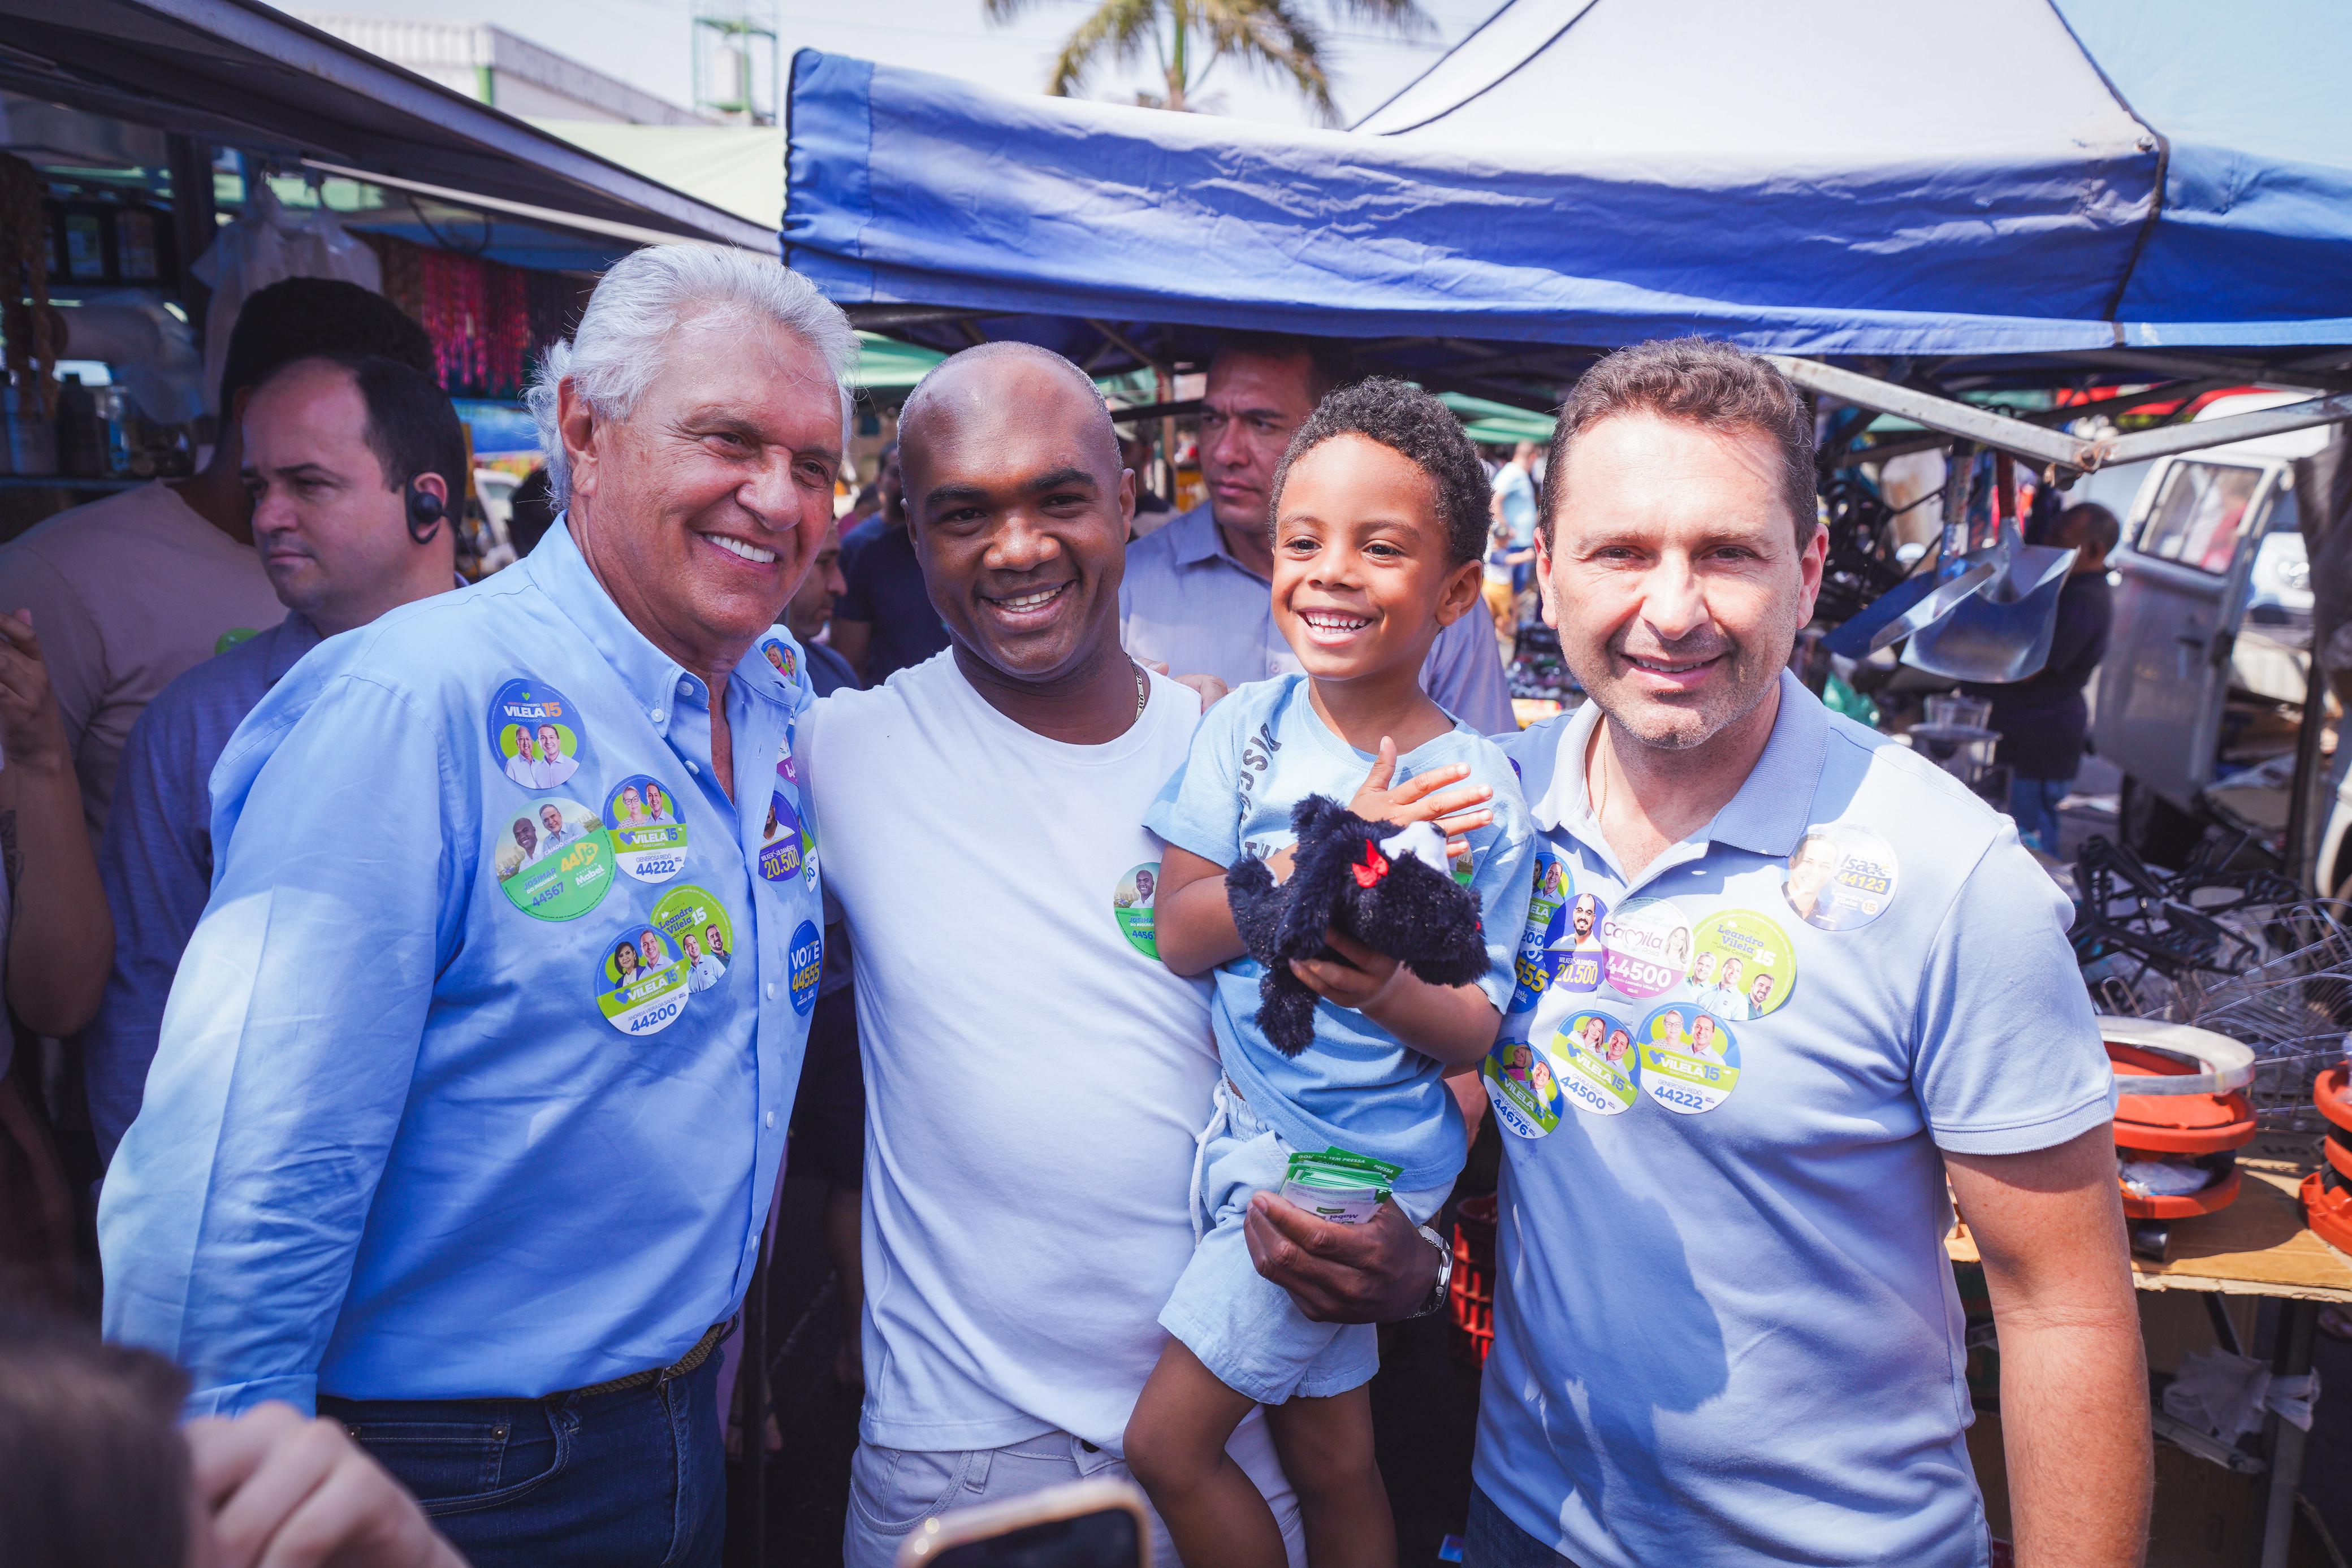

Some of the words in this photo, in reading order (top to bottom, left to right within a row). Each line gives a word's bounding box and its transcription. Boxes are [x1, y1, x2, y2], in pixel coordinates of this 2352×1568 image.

[503, 705, 546, 718] VILELA
[542, 701, 562, 717] 15
[631, 831, 669, 844] VILELA
[665, 828, 678, 841] 15
[544, 842, 564, 856] CAIADO
[760, 851, 775, 862] WILKER
[560, 852, 581, 873] 44
[636, 860, 676, 876] 44222
[764, 850, 800, 880] 20.500
[523, 867, 557, 890] JOSIMAR
[575, 864, 605, 886] Mabel
[1838, 872, 1887, 892] 44123
[532, 882, 564, 907] 44567
[658, 906, 693, 930] Leandro
[1863, 903, 1876, 912] 15
[666, 916, 692, 934] Vilela
[691, 906, 707, 926] 15
[679, 924, 695, 935] Campos
[1132, 930, 1155, 940] 4456
[1521, 930, 1545, 947] 200
[1717, 924, 1764, 947] Leandro
[790, 939, 820, 971] VOTE
[1642, 947, 1660, 957] Rosa
[1722, 935, 1754, 954] Vilela
[1752, 948, 1777, 967] 15
[1731, 949, 1753, 960] Campos
[792, 961, 820, 994] 44555
[1515, 956, 1550, 992] 555
[1554, 964, 1598, 985] 20.500
[1605, 955, 1672, 988] 44500
[626, 978, 668, 1001] VILELA
[664, 968, 678, 984] 15
[630, 1003, 677, 1032] 44200
[1576, 1052, 1612, 1084] VILELA
[1611, 1073, 1625, 1091] 15
[1660, 1056, 1705, 1078] VILELA
[1704, 1065, 1720, 1081] 15
[1560, 1076, 1606, 1110] 44500
[1572, 1073, 1591, 1088] CAMILA
[1589, 1085, 1603, 1096] ROSA
[1658, 1079, 1687, 1092] GENEROSA
[1504, 1077, 1534, 1112] VILELA
[1533, 1102, 1547, 1119] 15
[1654, 1086, 1703, 1110] 44222
[1493, 1099, 1529, 1136] 44676
[1510, 1106, 1530, 1127] POSTINHO
[1373, 1164, 1394, 1174] PRESSA
